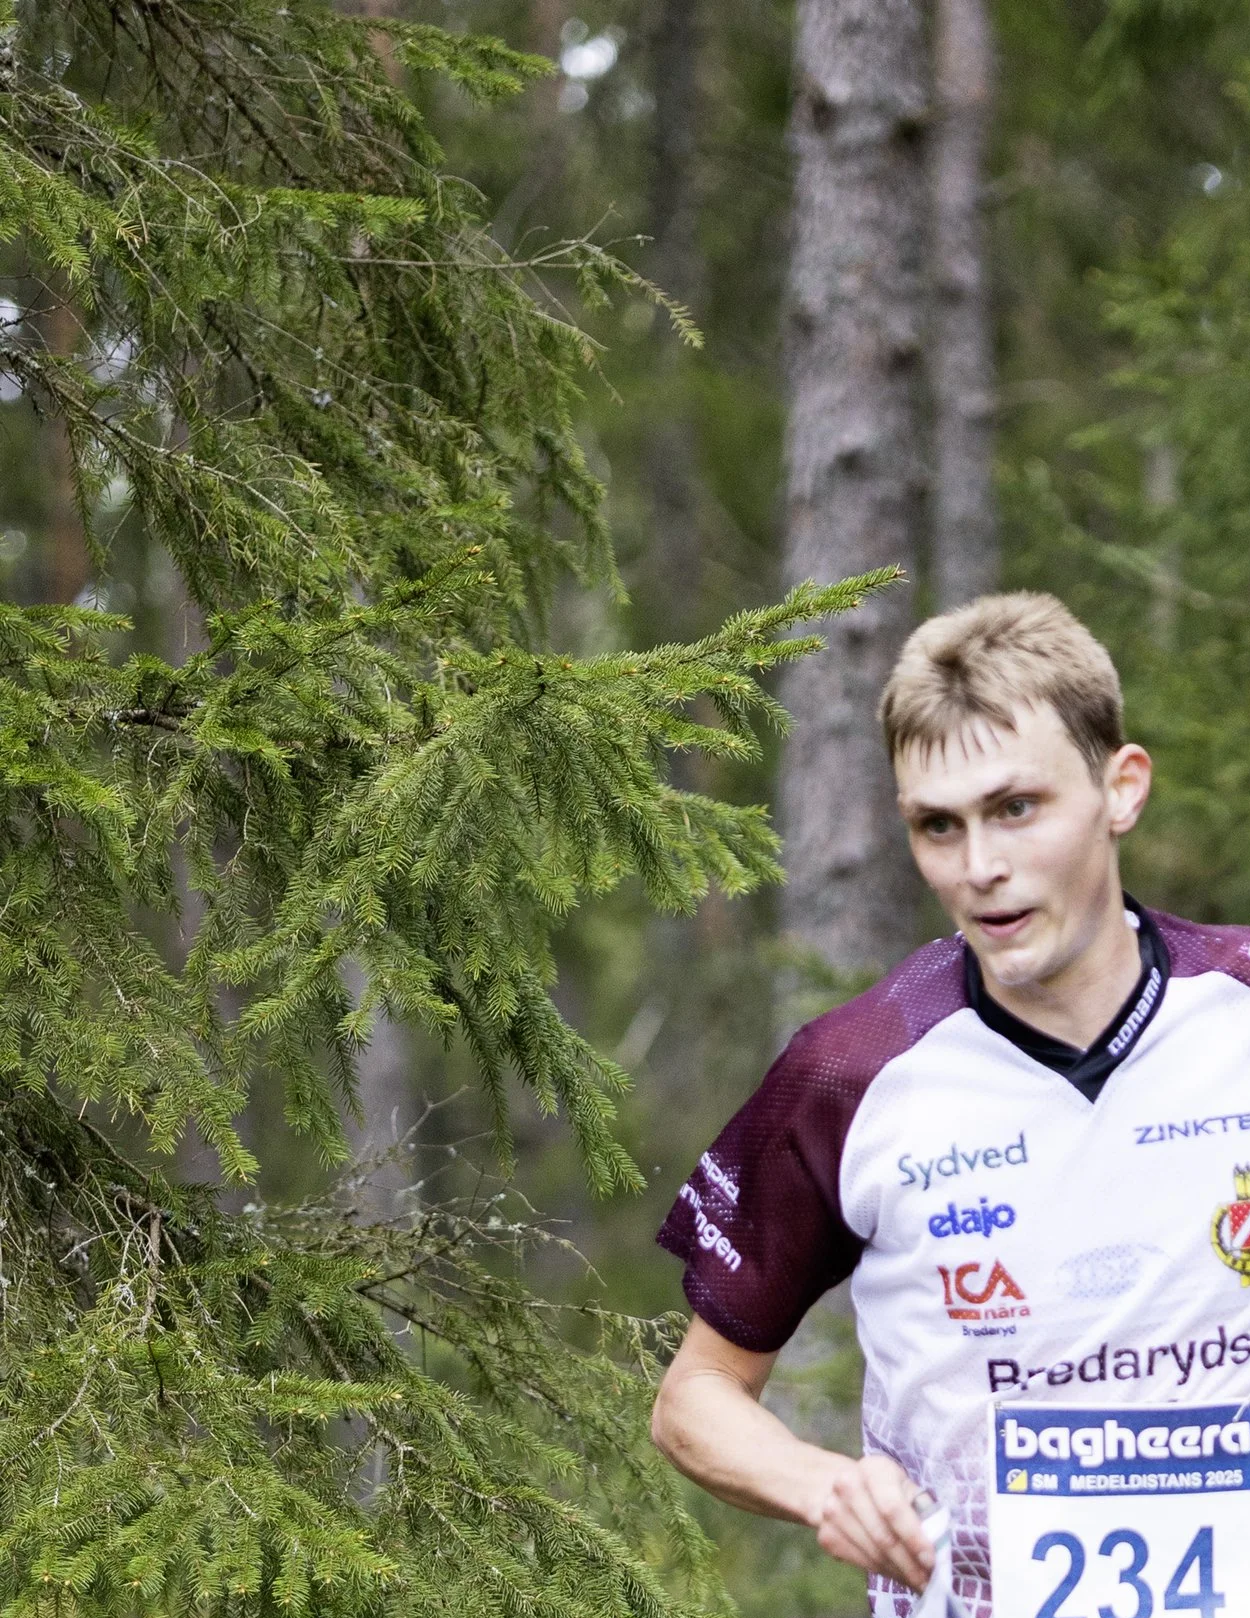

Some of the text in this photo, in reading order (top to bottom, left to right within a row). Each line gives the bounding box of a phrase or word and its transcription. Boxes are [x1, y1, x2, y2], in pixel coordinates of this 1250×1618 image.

[898, 1130, 1028, 1191] Sydved
[928, 1196, 1017, 1238] elajo
[937, 1257, 1026, 1305] ICA
[984, 1304, 1031, 1320] nära
[962, 1324, 1017, 1337] Bredaryd
[1031, 1469, 1244, 1491] SM MEDELDISTANS 2025
